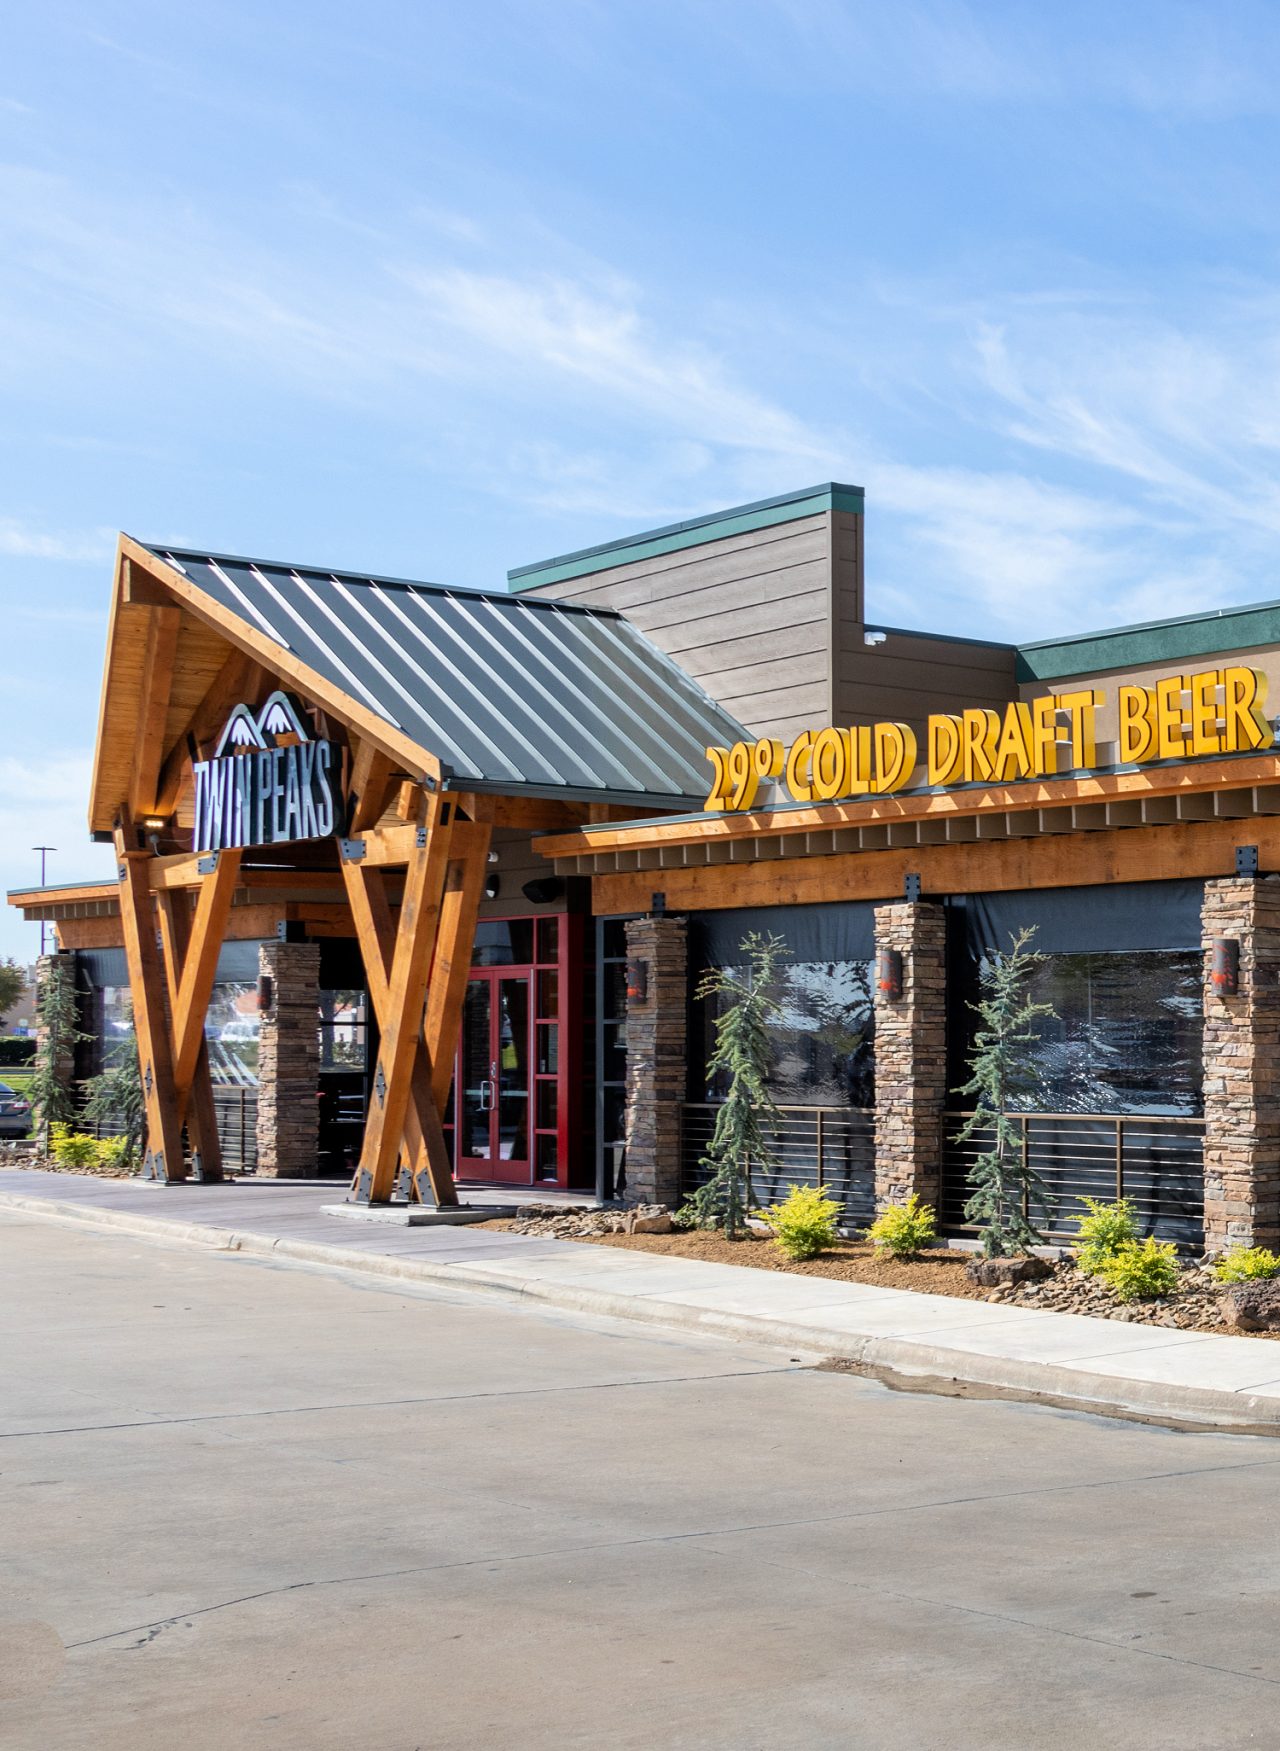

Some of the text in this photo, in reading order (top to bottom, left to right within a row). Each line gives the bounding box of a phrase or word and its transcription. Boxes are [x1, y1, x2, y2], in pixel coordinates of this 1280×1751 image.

[786, 721, 917, 802] COLD
[928, 689, 1104, 786] DRAFT
[1118, 665, 1274, 764] BEER
[193, 740, 334, 852] TWIN PEAKS
